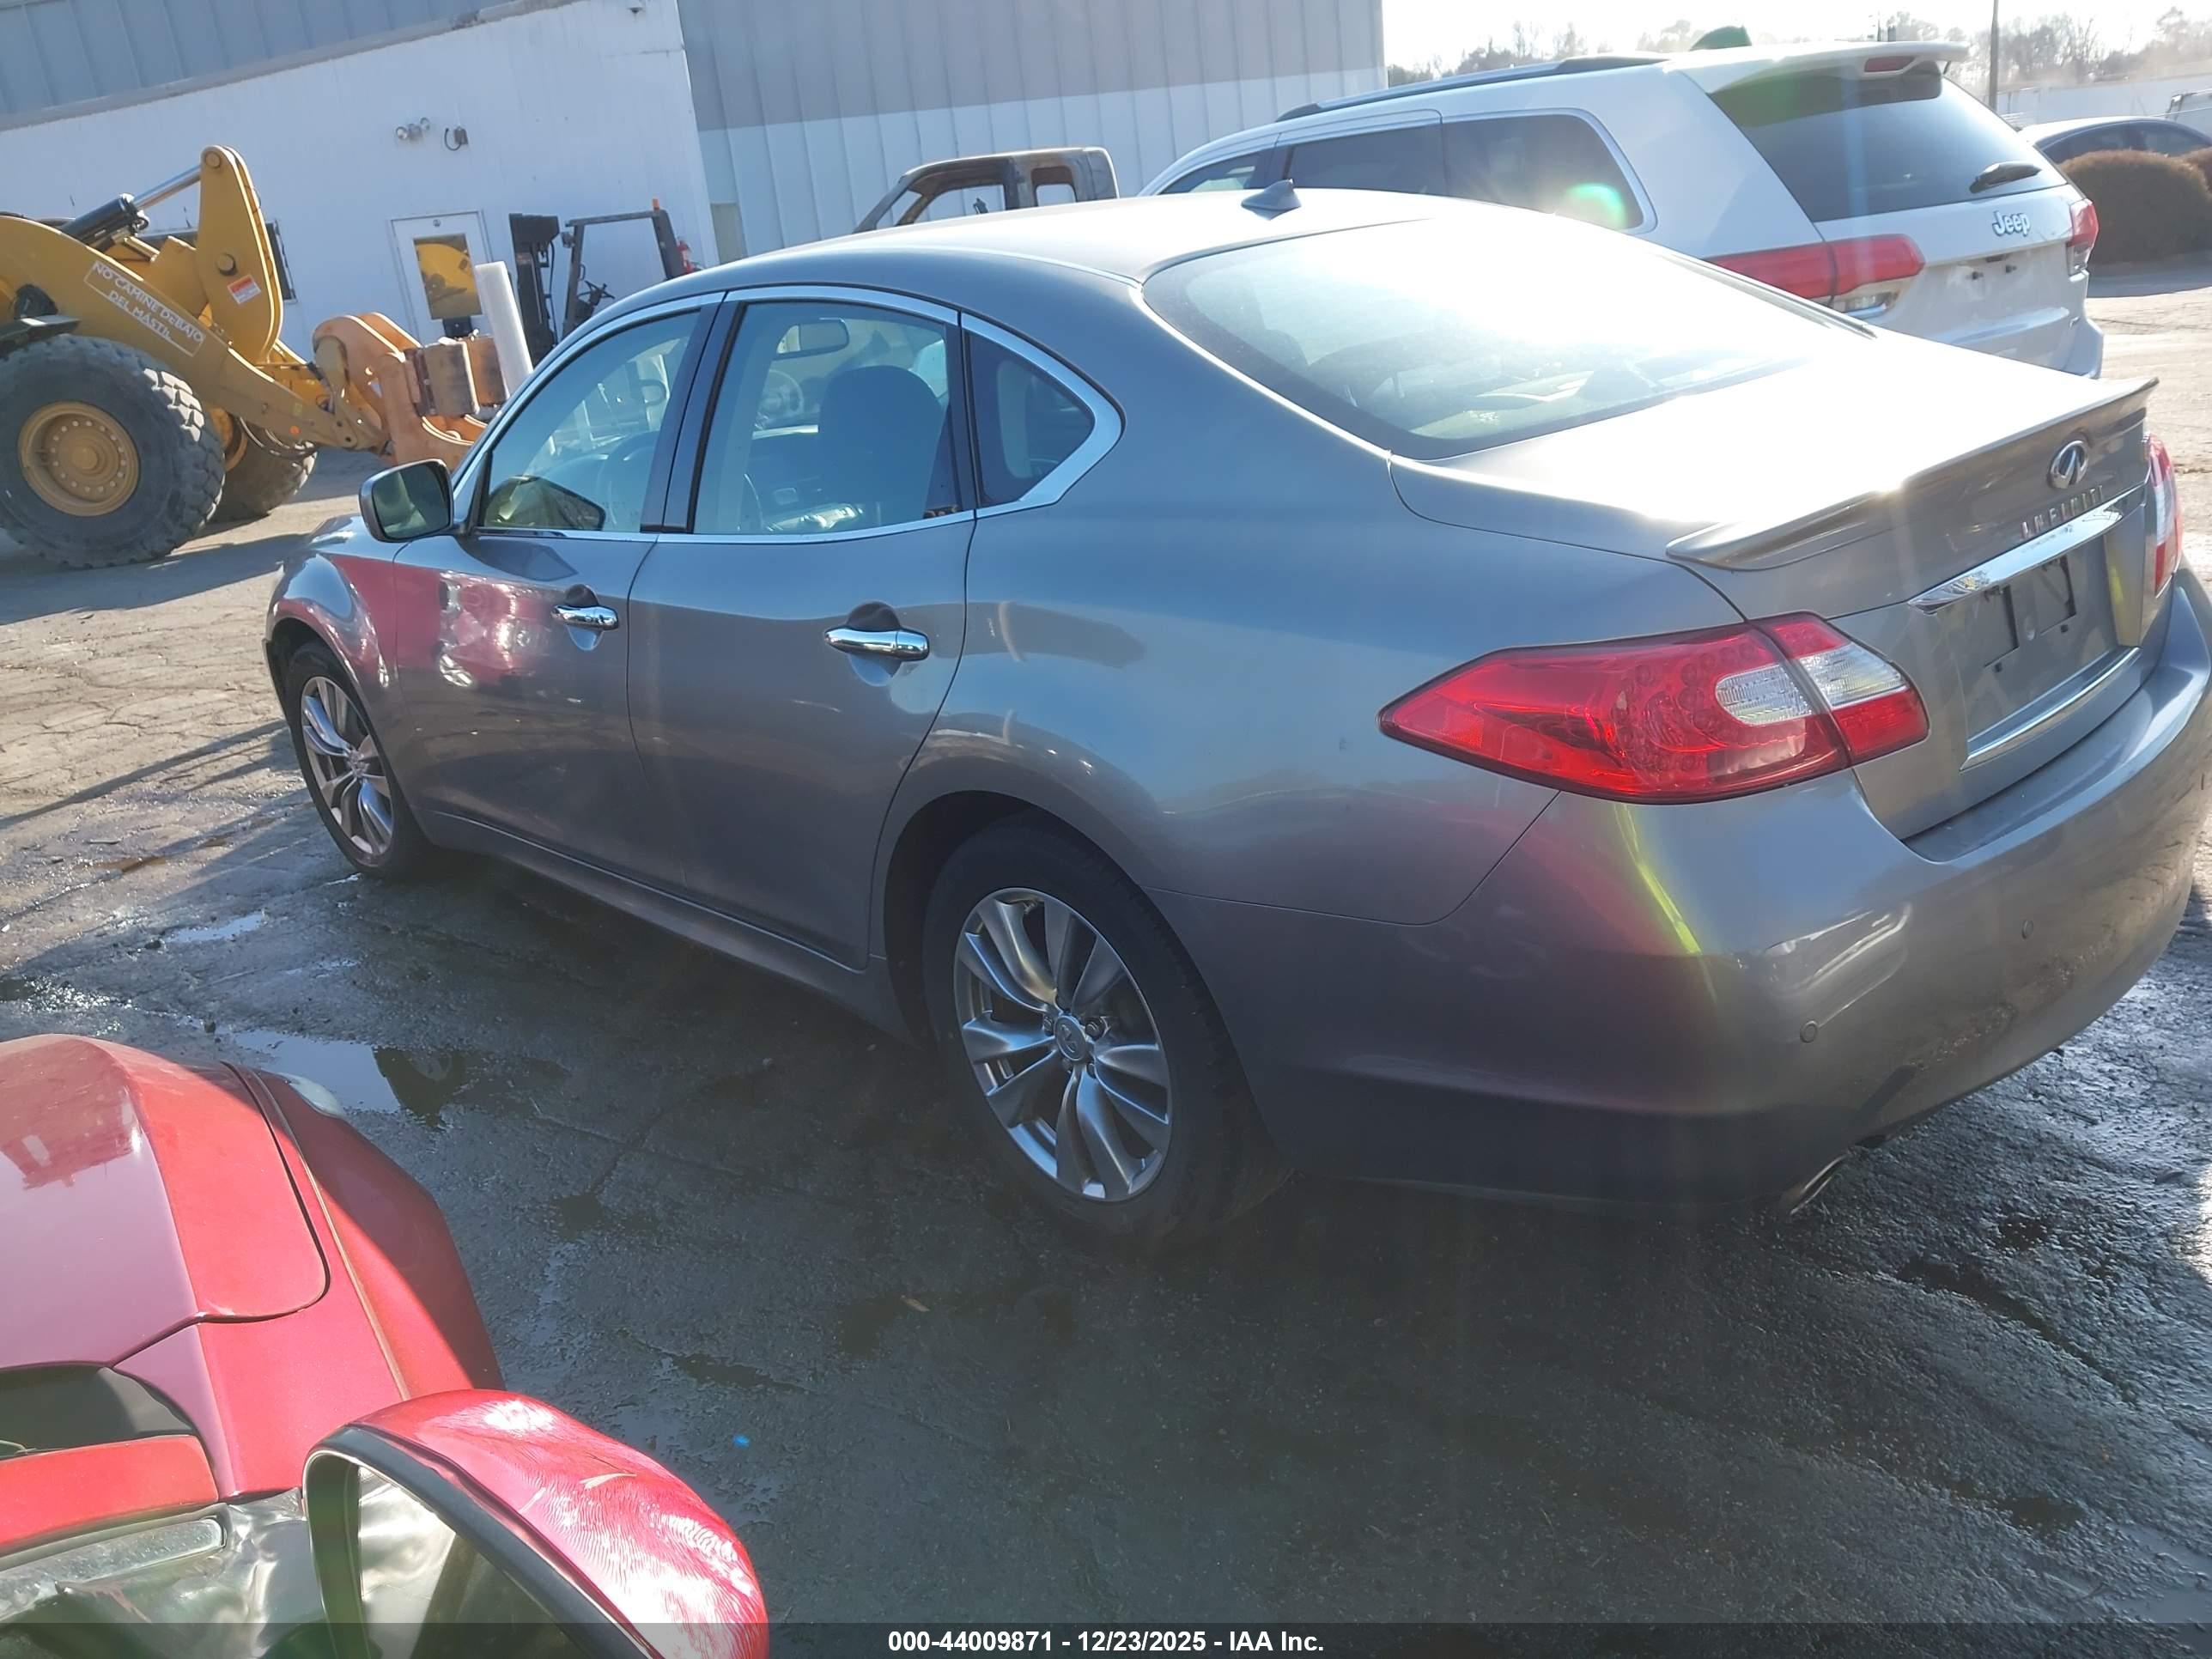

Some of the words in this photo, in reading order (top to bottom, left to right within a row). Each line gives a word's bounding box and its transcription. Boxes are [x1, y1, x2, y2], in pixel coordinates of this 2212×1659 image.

[1992, 210, 2031, 236] Jeep
[93, 261, 112, 279] NO
[115, 276, 158, 313] CAMINE
[160, 307, 204, 342] DEBAJO
[108, 290, 130, 308] DEL
[2021, 485, 2102, 539] INFINITI
